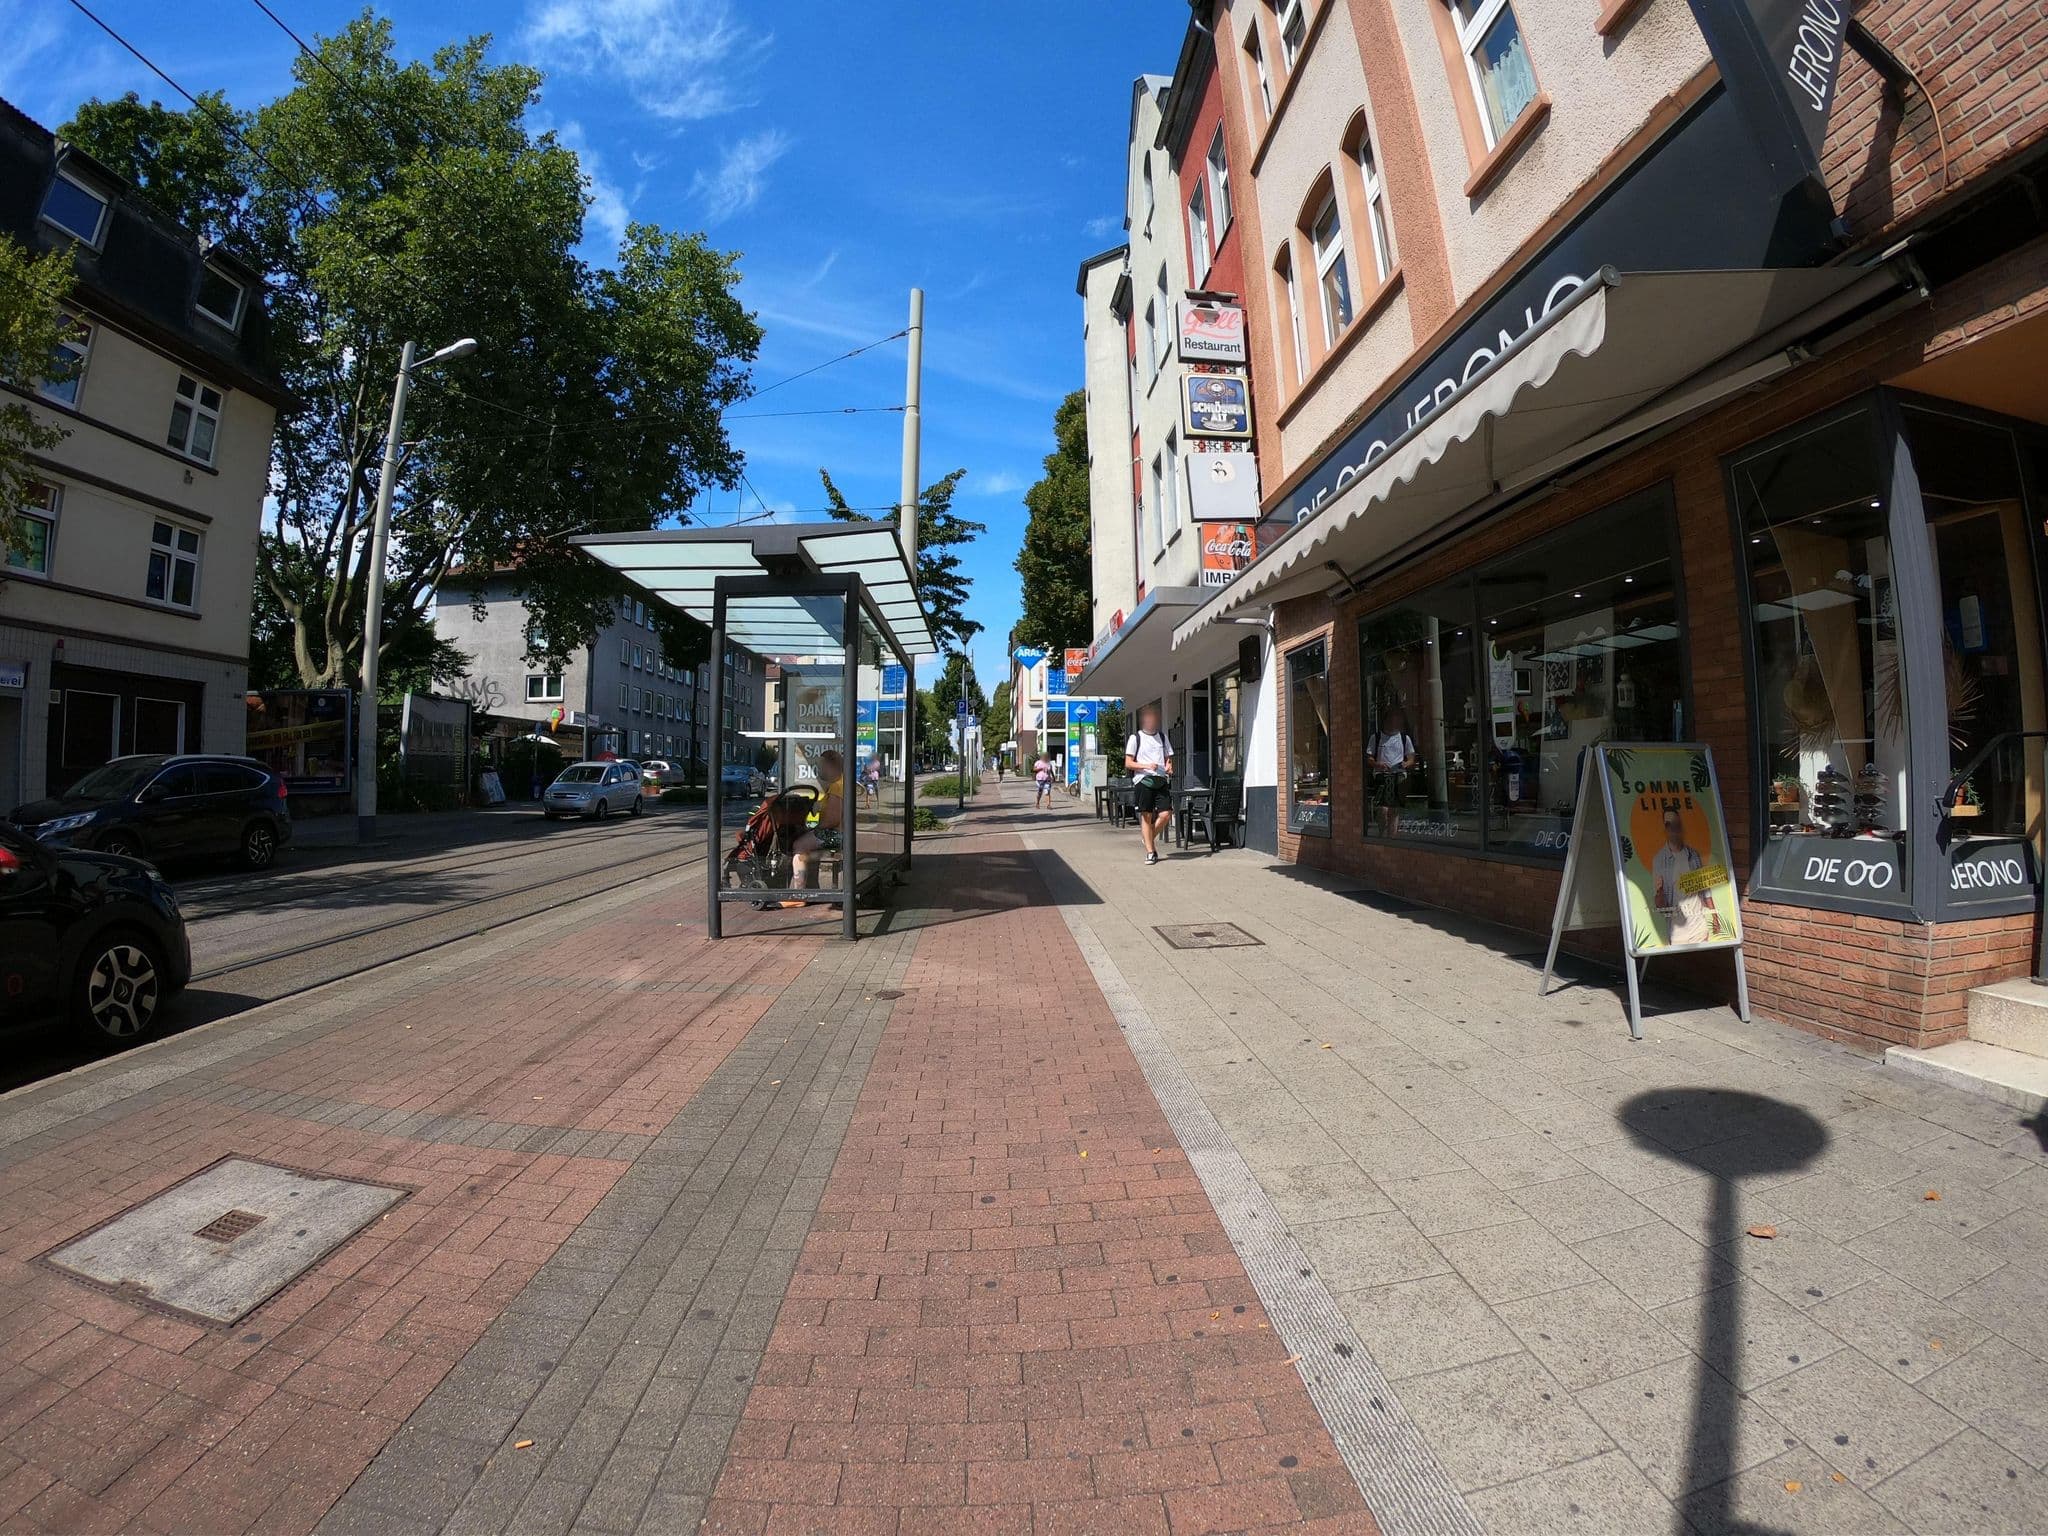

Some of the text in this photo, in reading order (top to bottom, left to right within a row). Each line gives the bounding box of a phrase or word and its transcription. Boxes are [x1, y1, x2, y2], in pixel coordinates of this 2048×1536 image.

[1788, 0, 1841, 111] JERONO
[1184, 337, 1241, 353] Restaurant
[1205, 538, 1251, 557] Coca-Cola
[1206, 572, 1236, 583] IMB
[1018, 648, 1042, 657] ARAL
[799, 703, 841, 717] DANKE
[1622, 780, 1704, 794] SOMMER
[1641, 796, 1693, 811] LIEBE
[1804, 856, 1842, 883] DIE
[1950, 859, 2023, 890] JERONO
